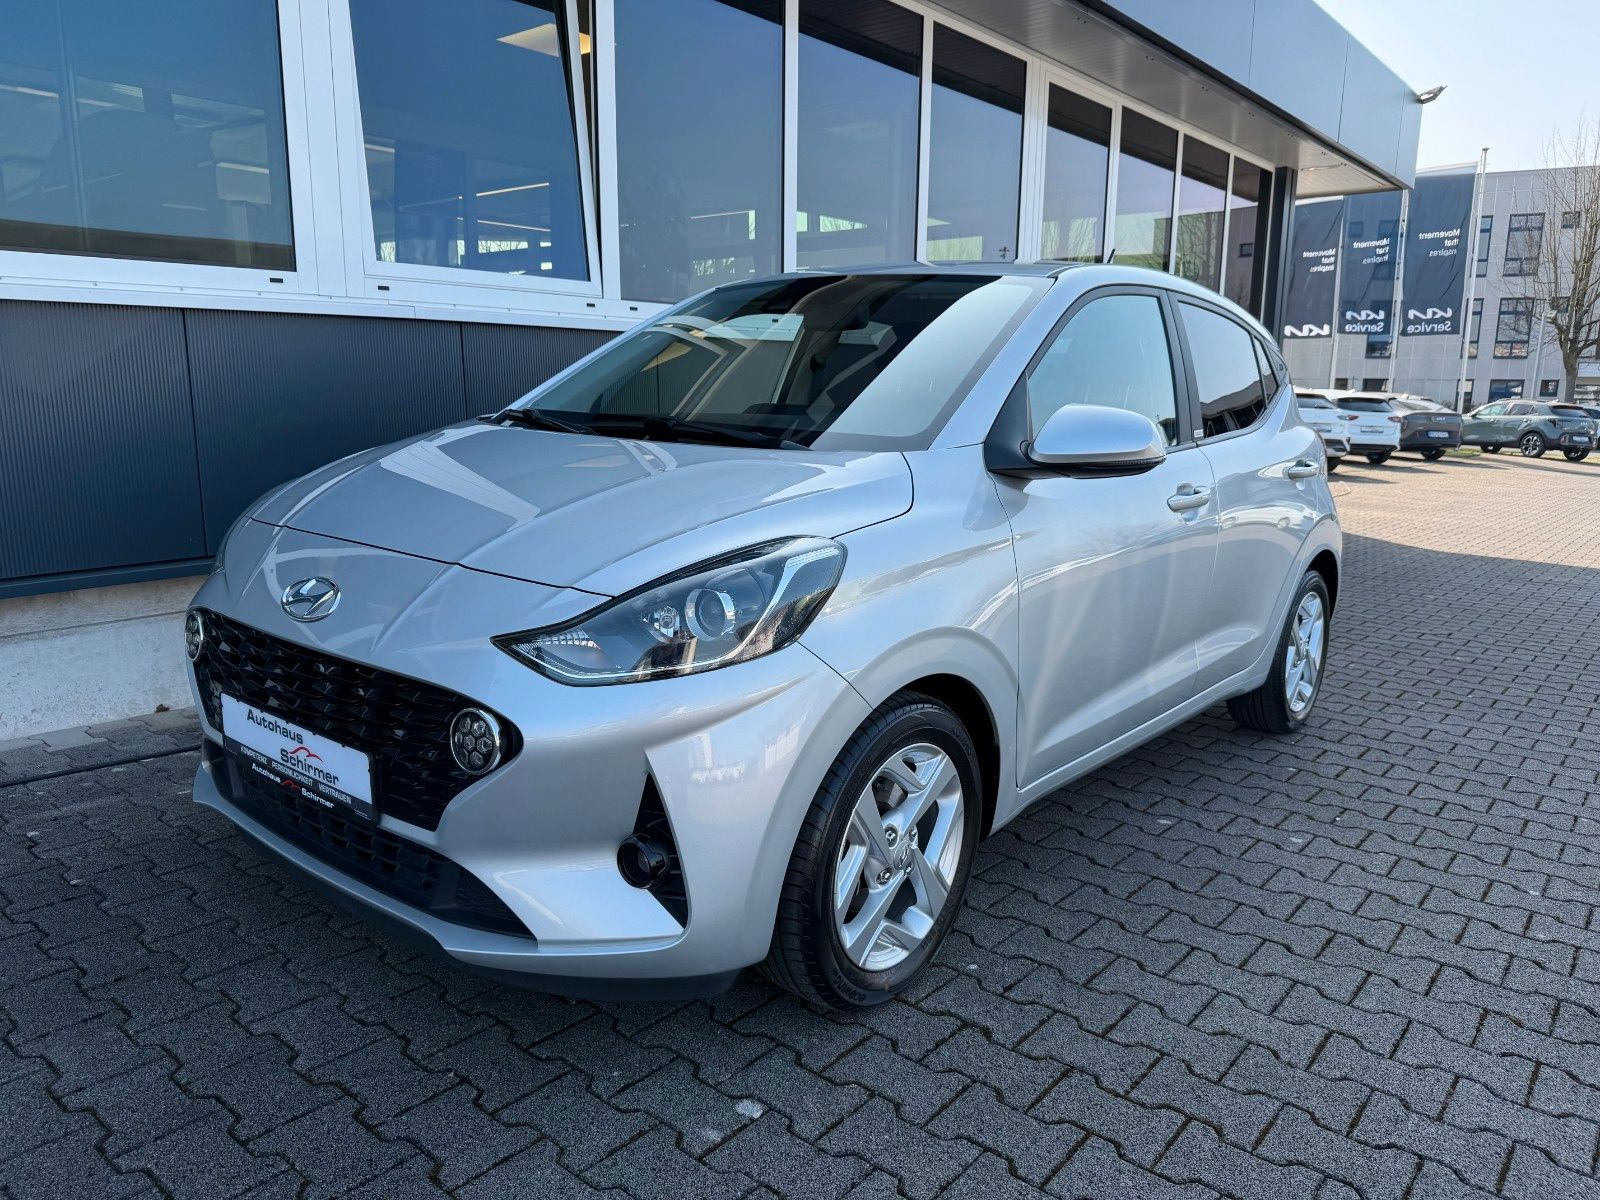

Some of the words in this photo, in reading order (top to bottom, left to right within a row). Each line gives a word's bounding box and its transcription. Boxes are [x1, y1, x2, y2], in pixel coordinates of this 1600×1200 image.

[246, 708, 304, 745] Autohaus
[280, 748, 340, 786] Schirmer
[251, 763, 281, 784] Autohaus
[301, 787, 335, 809] Schirmer
[318, 782, 352, 805] VERTRAUEN
